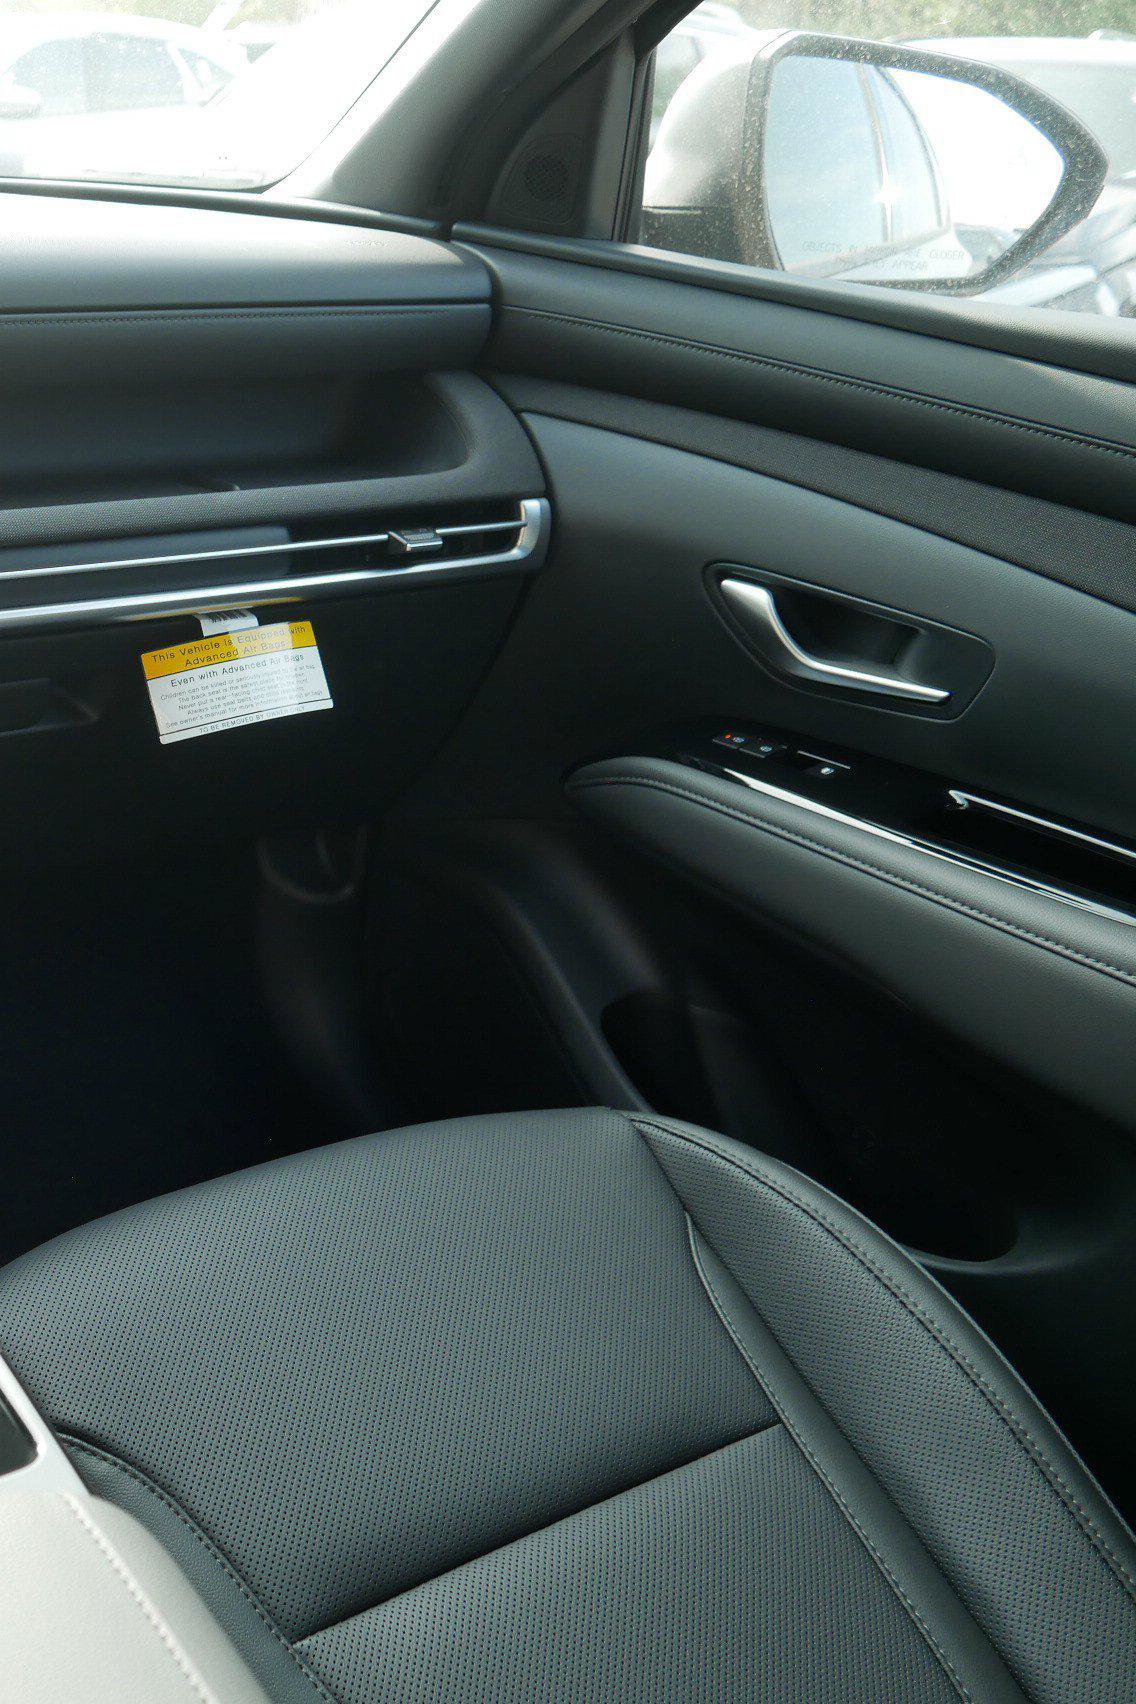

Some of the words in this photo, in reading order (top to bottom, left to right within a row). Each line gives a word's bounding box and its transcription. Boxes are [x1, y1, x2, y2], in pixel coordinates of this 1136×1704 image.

[151, 652, 176, 663] This
[179, 641, 221, 656] Vehicle
[224, 638, 234, 647] is
[289, 625, 307, 635] with
[185, 649, 239, 667] Advanced
[243, 645, 257, 655] Air
[170, 676, 195, 688] Even
[198, 669, 219, 680] with
[221, 660, 267, 676] Advanced
[270, 656, 282, 665] Air
